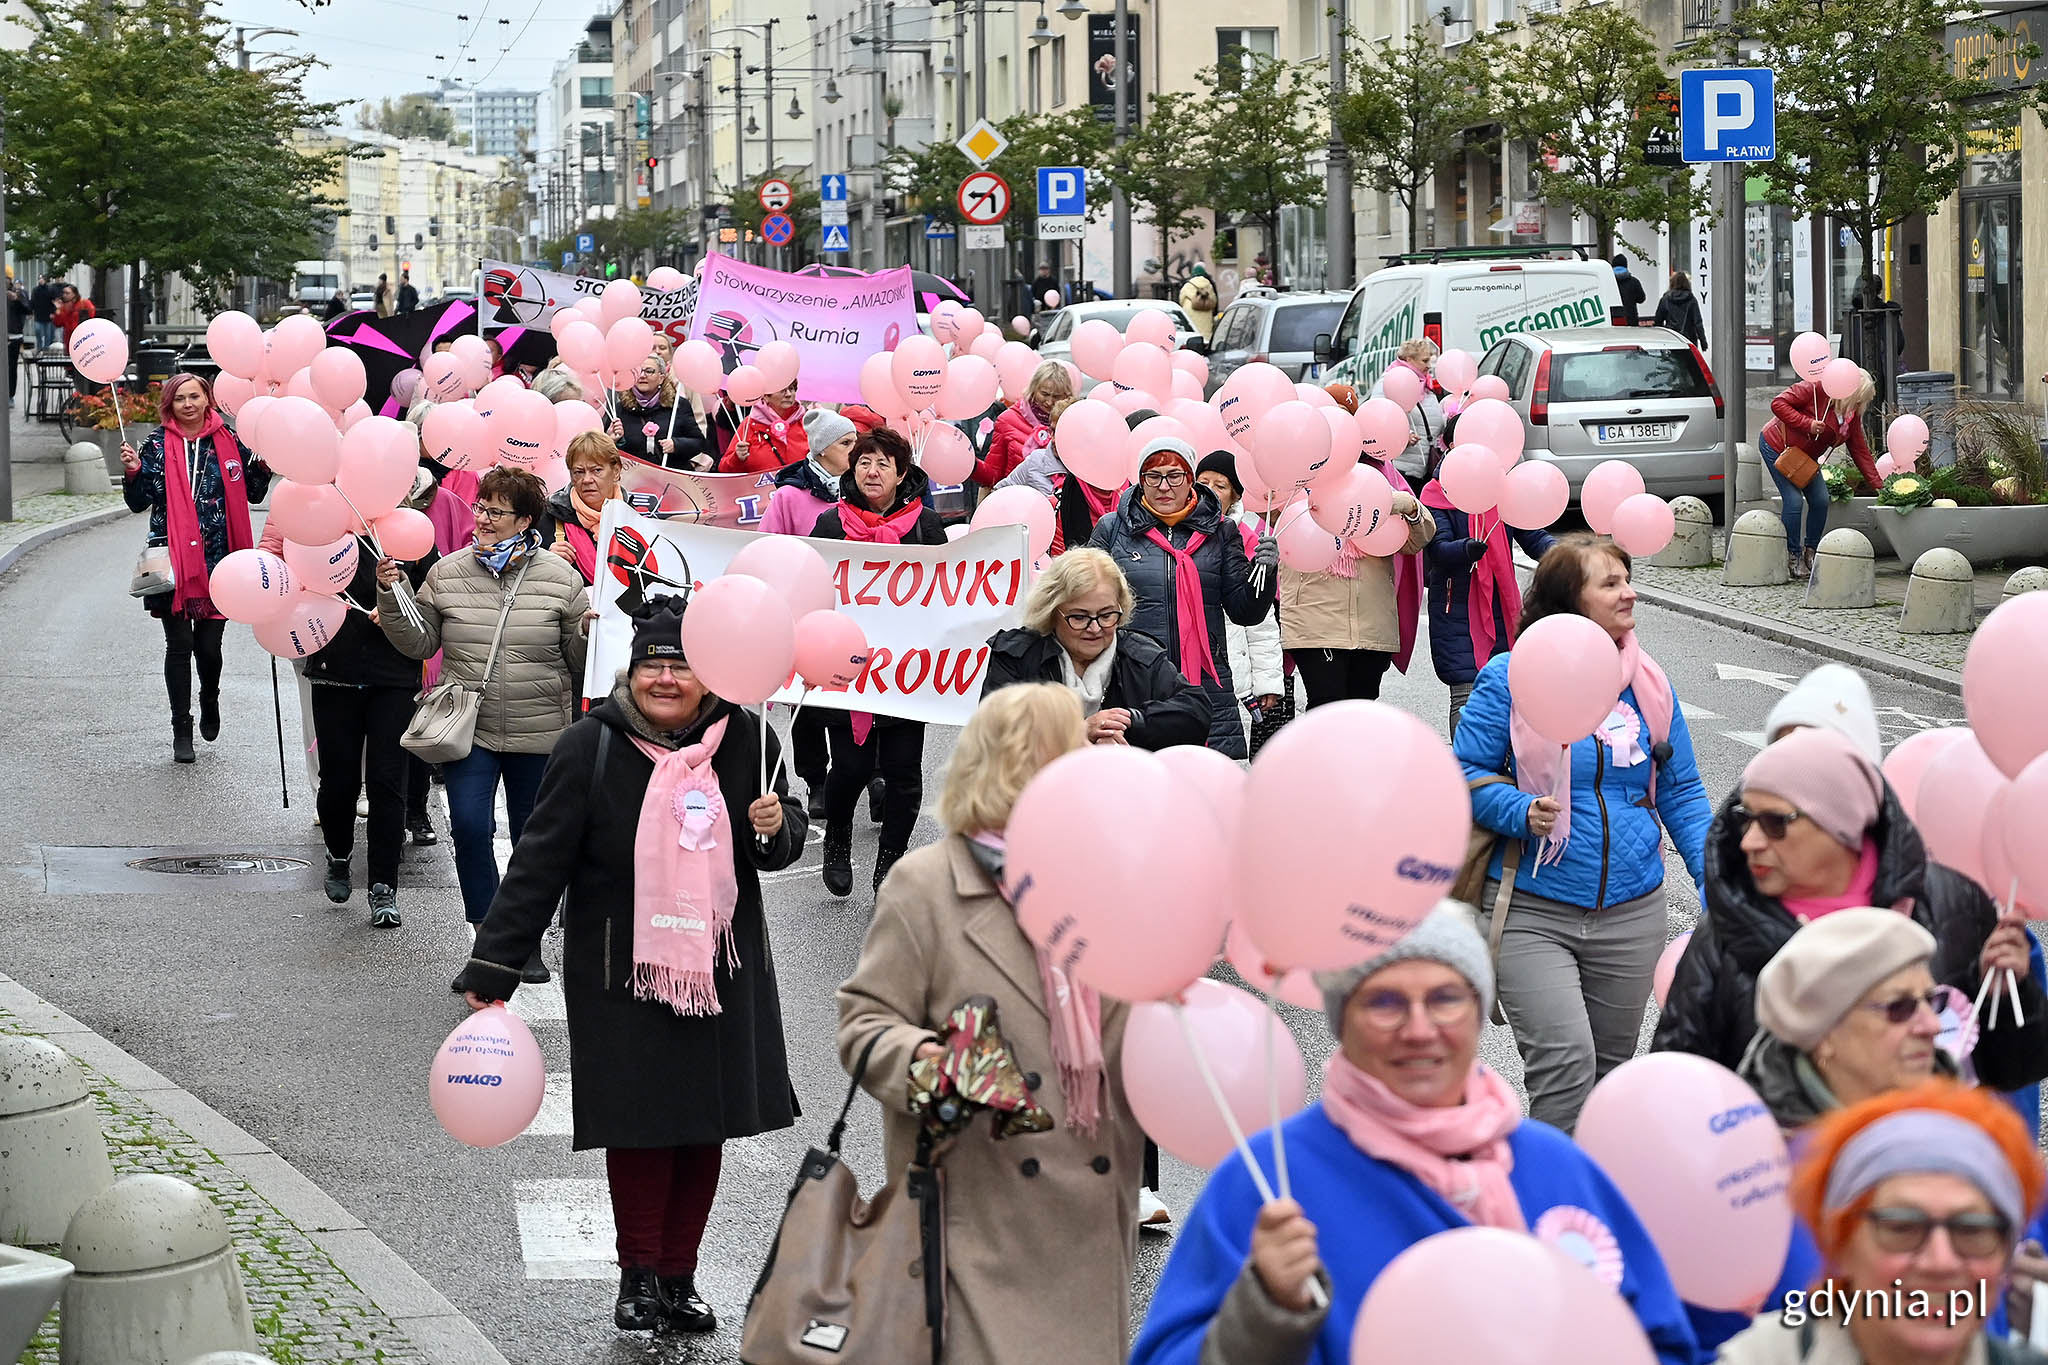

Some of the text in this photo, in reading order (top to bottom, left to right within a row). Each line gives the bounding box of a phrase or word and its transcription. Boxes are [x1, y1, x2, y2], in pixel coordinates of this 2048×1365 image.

[1704, 80, 1754, 150] P
[1726, 146, 1771, 157] PŁATNY
[1048, 172, 1075, 210] P
[1041, 220, 1083, 234] Koniec
[714, 270, 838, 310] Stowarzyszenie
[1451, 282, 1522, 293] www.megamini.pl
[789, 320, 860, 345] Rumia
[913, 369, 941, 377] GDYNIA
[1608, 423, 1667, 438] GA 138ET
[506, 437, 540, 448] GDYNIA
[329, 541, 354, 565] GDYNIA
[257, 557, 270, 590] GDYNIA
[833, 558, 1021, 607] AZONKI
[651, 913, 706, 931] GDYNIA
[447, 1074, 502, 1087] GDYNIA
